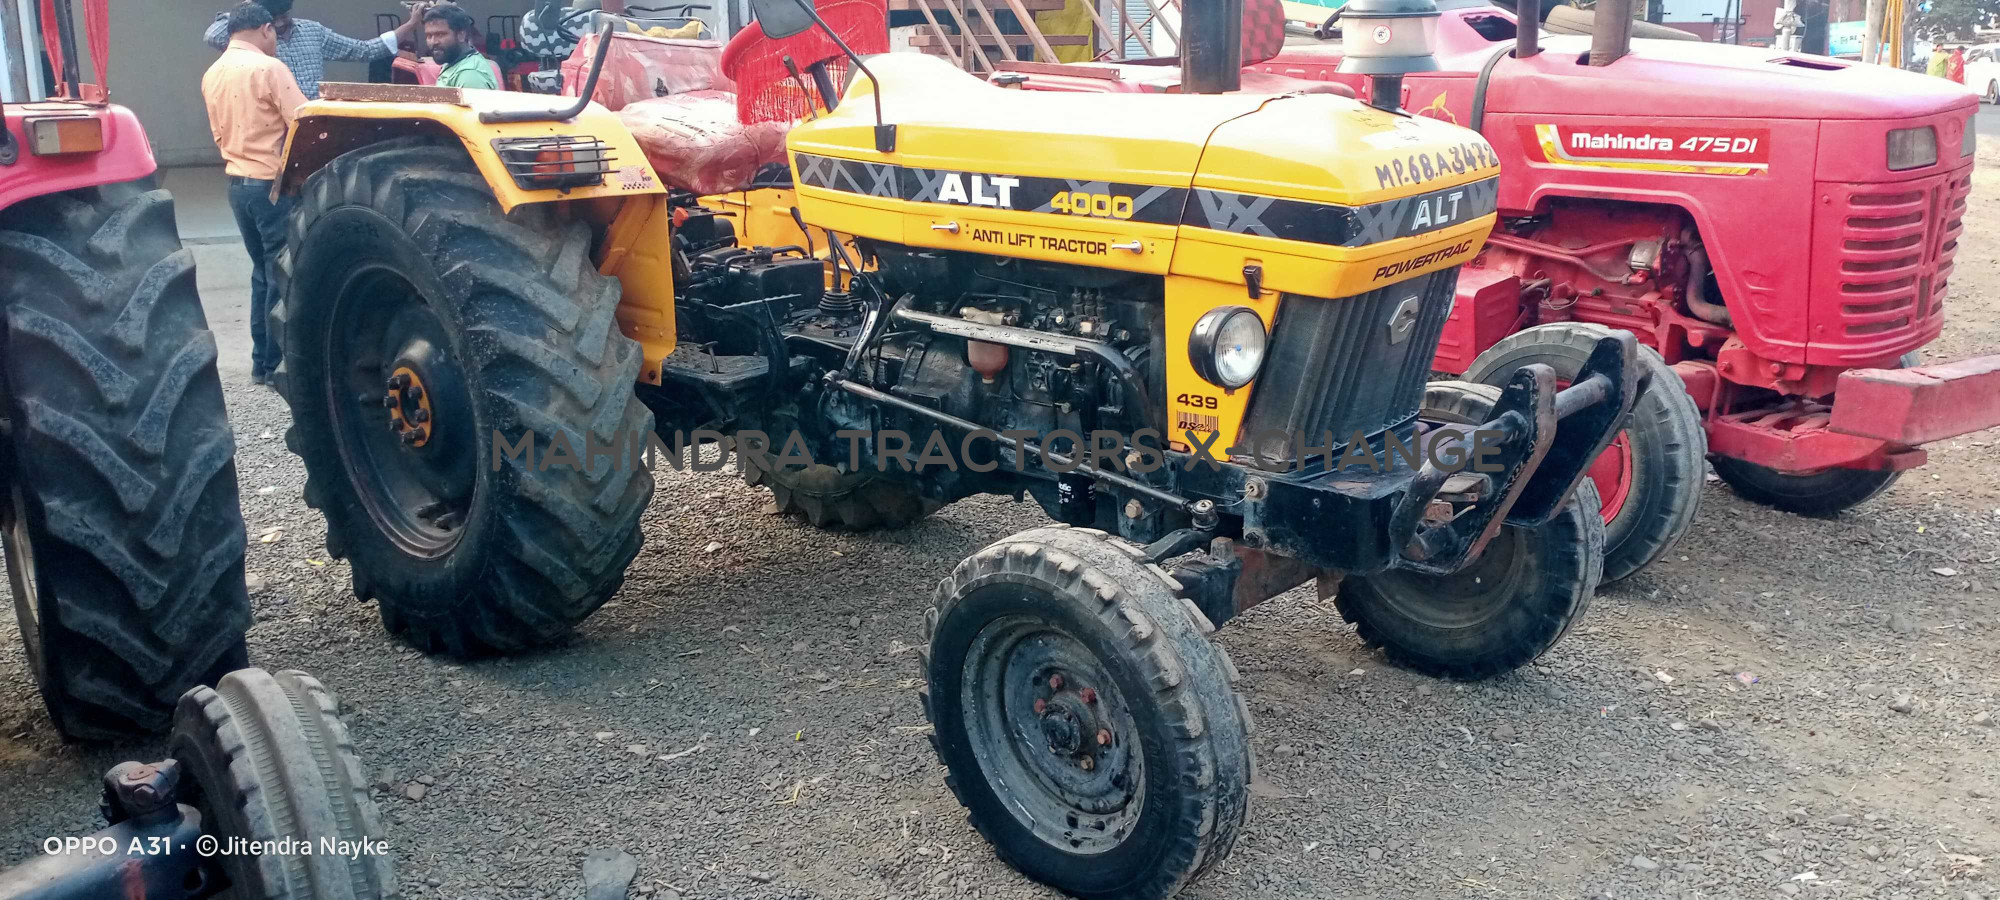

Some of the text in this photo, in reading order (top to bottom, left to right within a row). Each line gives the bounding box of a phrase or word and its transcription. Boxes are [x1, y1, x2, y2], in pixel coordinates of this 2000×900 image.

[1571, 132, 1758, 153] Mahindra 475DI
[938, 173, 1134, 219] ALT 4000
[1411, 191, 1464, 231] ALT
[972, 228, 1108, 256] ANTI LIFT TRACTOR
[1372, 239, 1473, 282] POWERTRAC
[1176, 393, 1218, 410] 439
